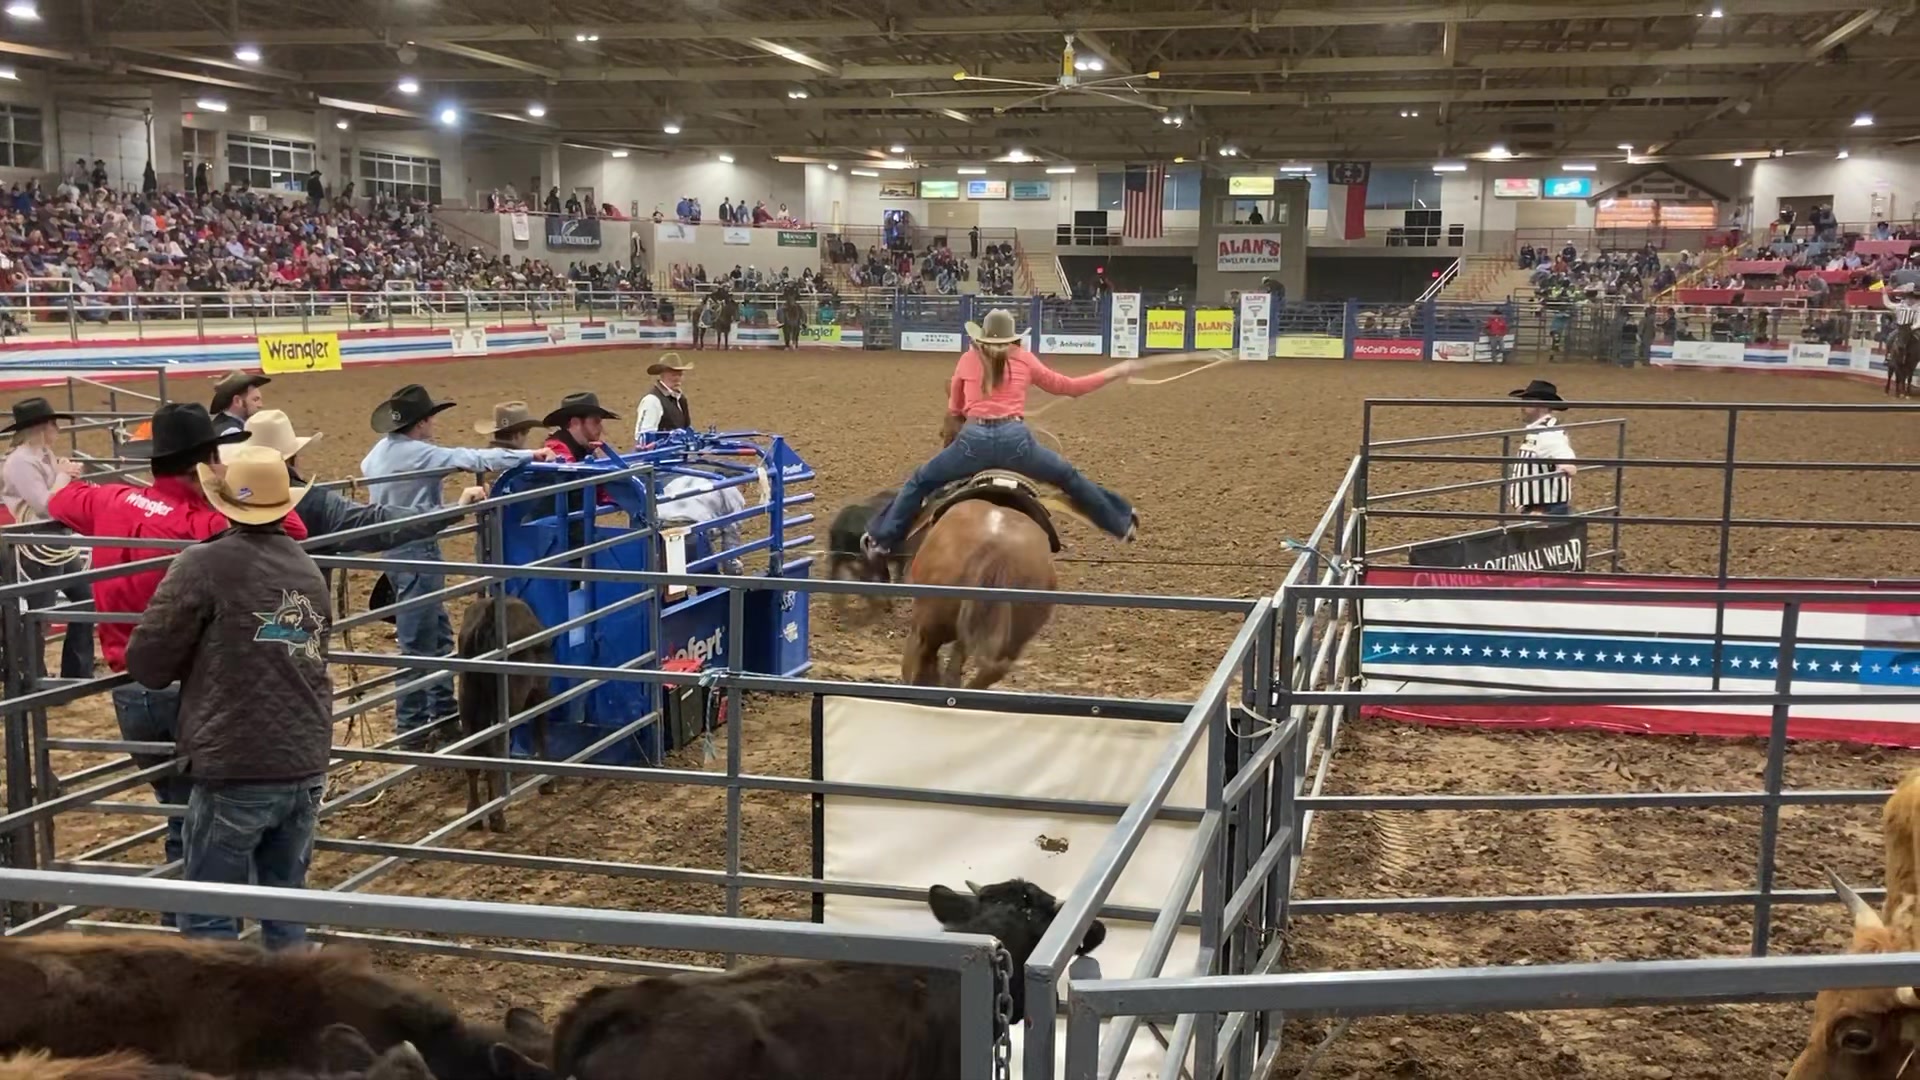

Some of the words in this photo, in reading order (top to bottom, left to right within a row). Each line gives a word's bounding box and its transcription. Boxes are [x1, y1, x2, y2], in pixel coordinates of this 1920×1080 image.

[1219, 239, 1280, 256] ALAN'S
[799, 326, 834, 341] angler
[1148, 321, 1184, 332] ALAN'S
[1197, 321, 1232, 332] ALAN'S
[265, 339, 328, 368] Wrangler
[1354, 345, 1388, 354] McCall's
[1390, 346, 1422, 356] Grading
[1543, 538, 1582, 571] WEAR
[663, 627, 723, 662] efert
